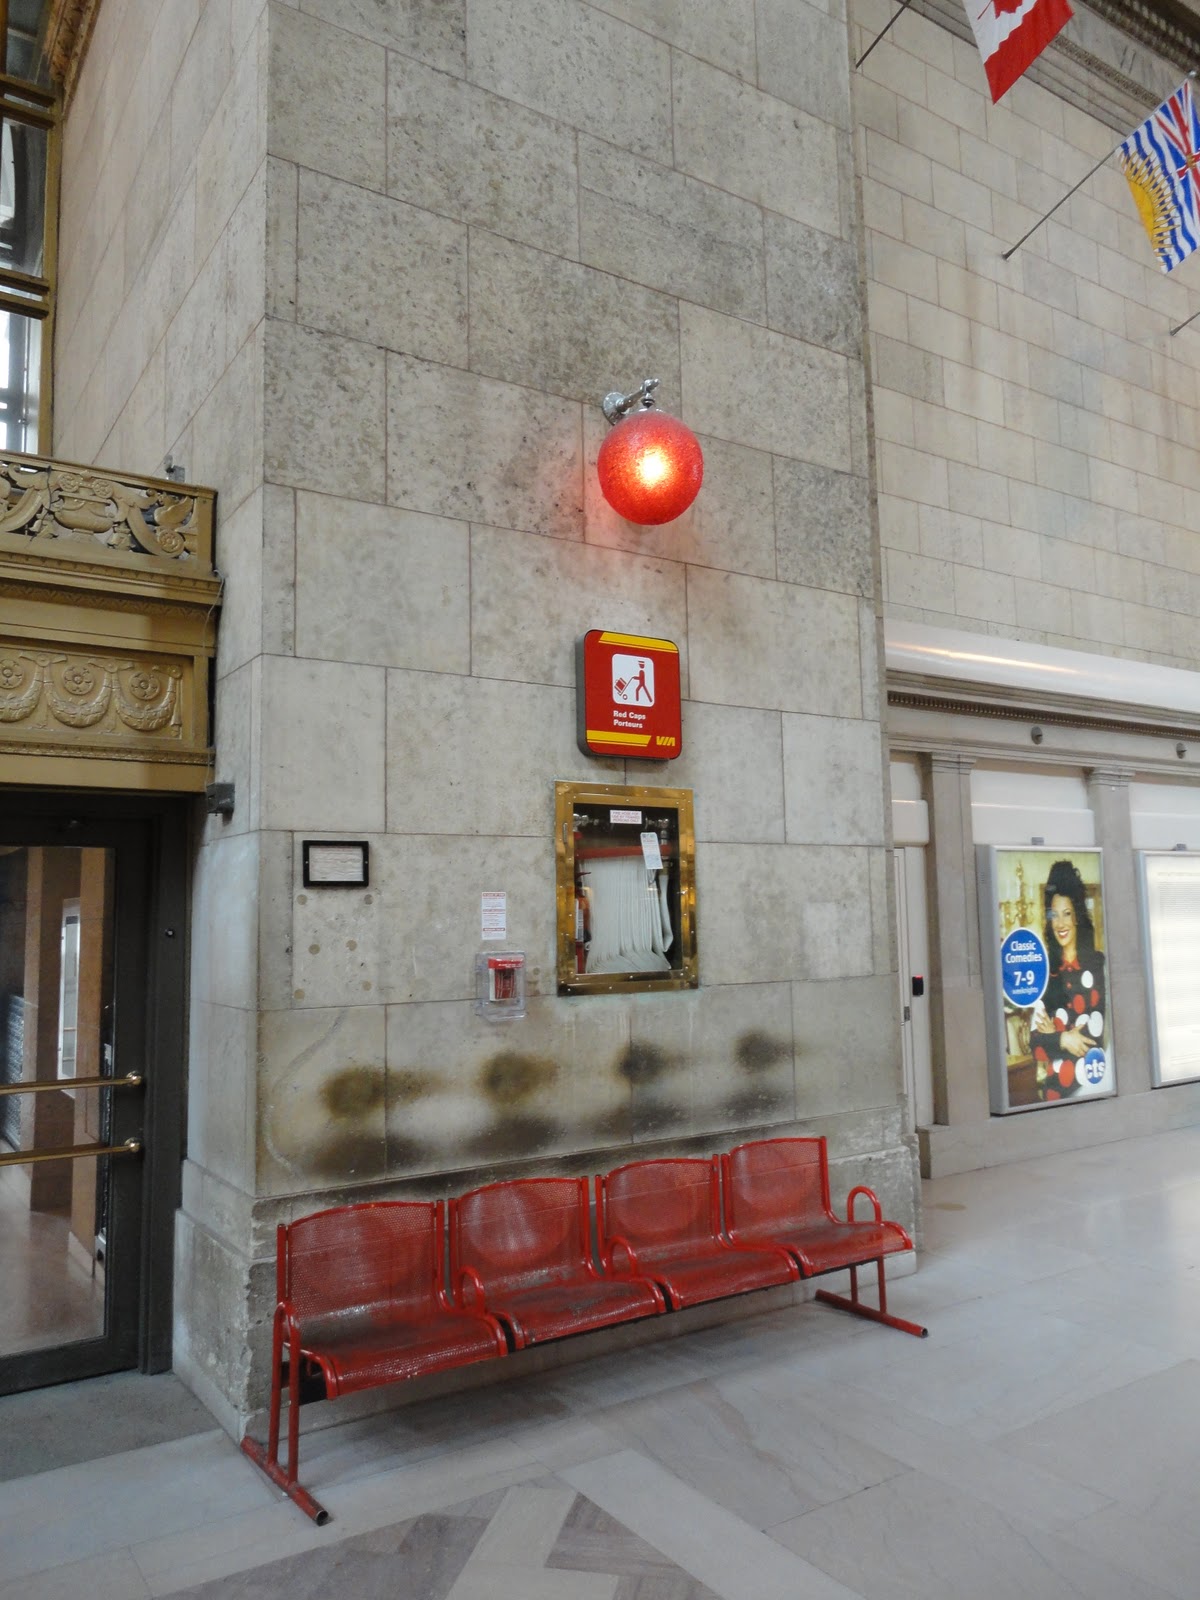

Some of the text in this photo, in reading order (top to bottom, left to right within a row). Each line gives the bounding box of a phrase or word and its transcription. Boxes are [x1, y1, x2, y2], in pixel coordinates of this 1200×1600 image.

[613, 710, 646, 720] Red Caps
[613, 719, 643, 729] Porteurs
[656, 736, 676, 747] VIA
[1010, 940, 1036, 951] Classic
[1005, 951, 1043, 963] Comedies
[1013, 970, 1035, 986] 7-9
